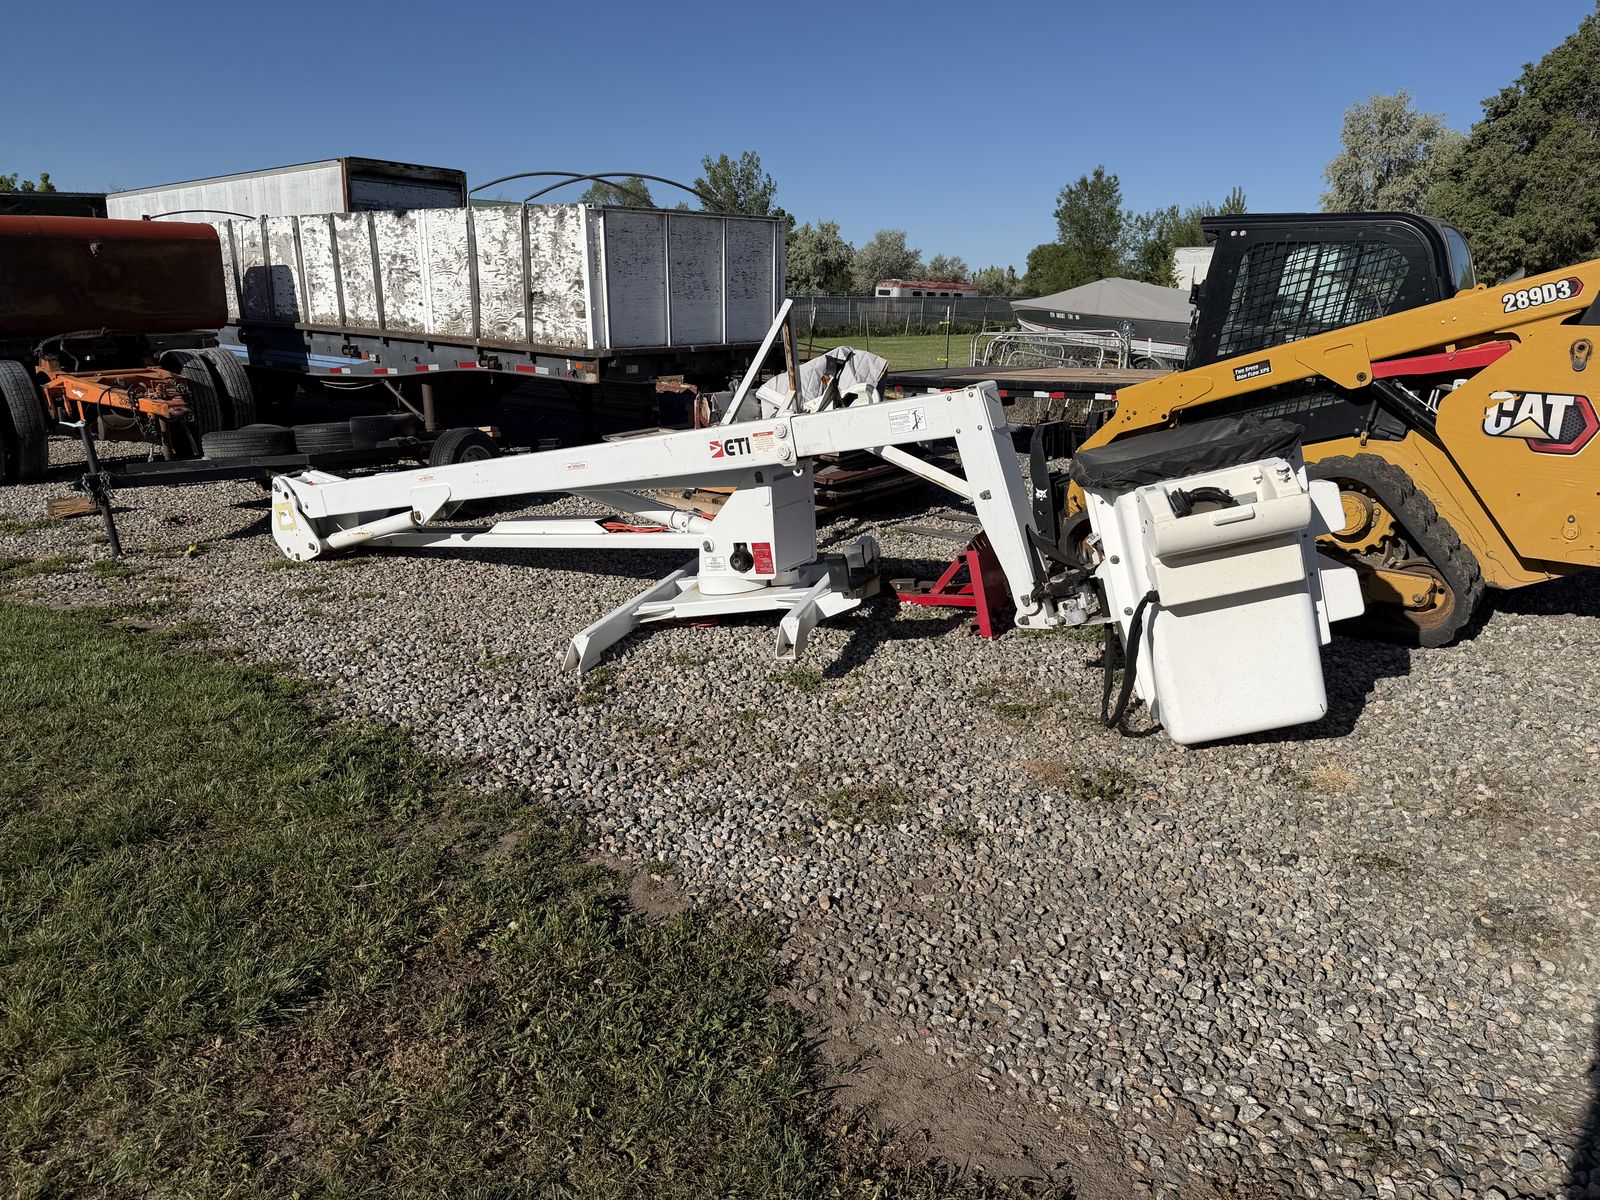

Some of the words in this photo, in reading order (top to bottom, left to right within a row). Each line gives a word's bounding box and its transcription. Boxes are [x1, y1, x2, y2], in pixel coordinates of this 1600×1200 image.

[1502, 280, 1572, 313] 289D3
[1484, 391, 1575, 440] CAT
[724, 437, 751, 456] ETI
